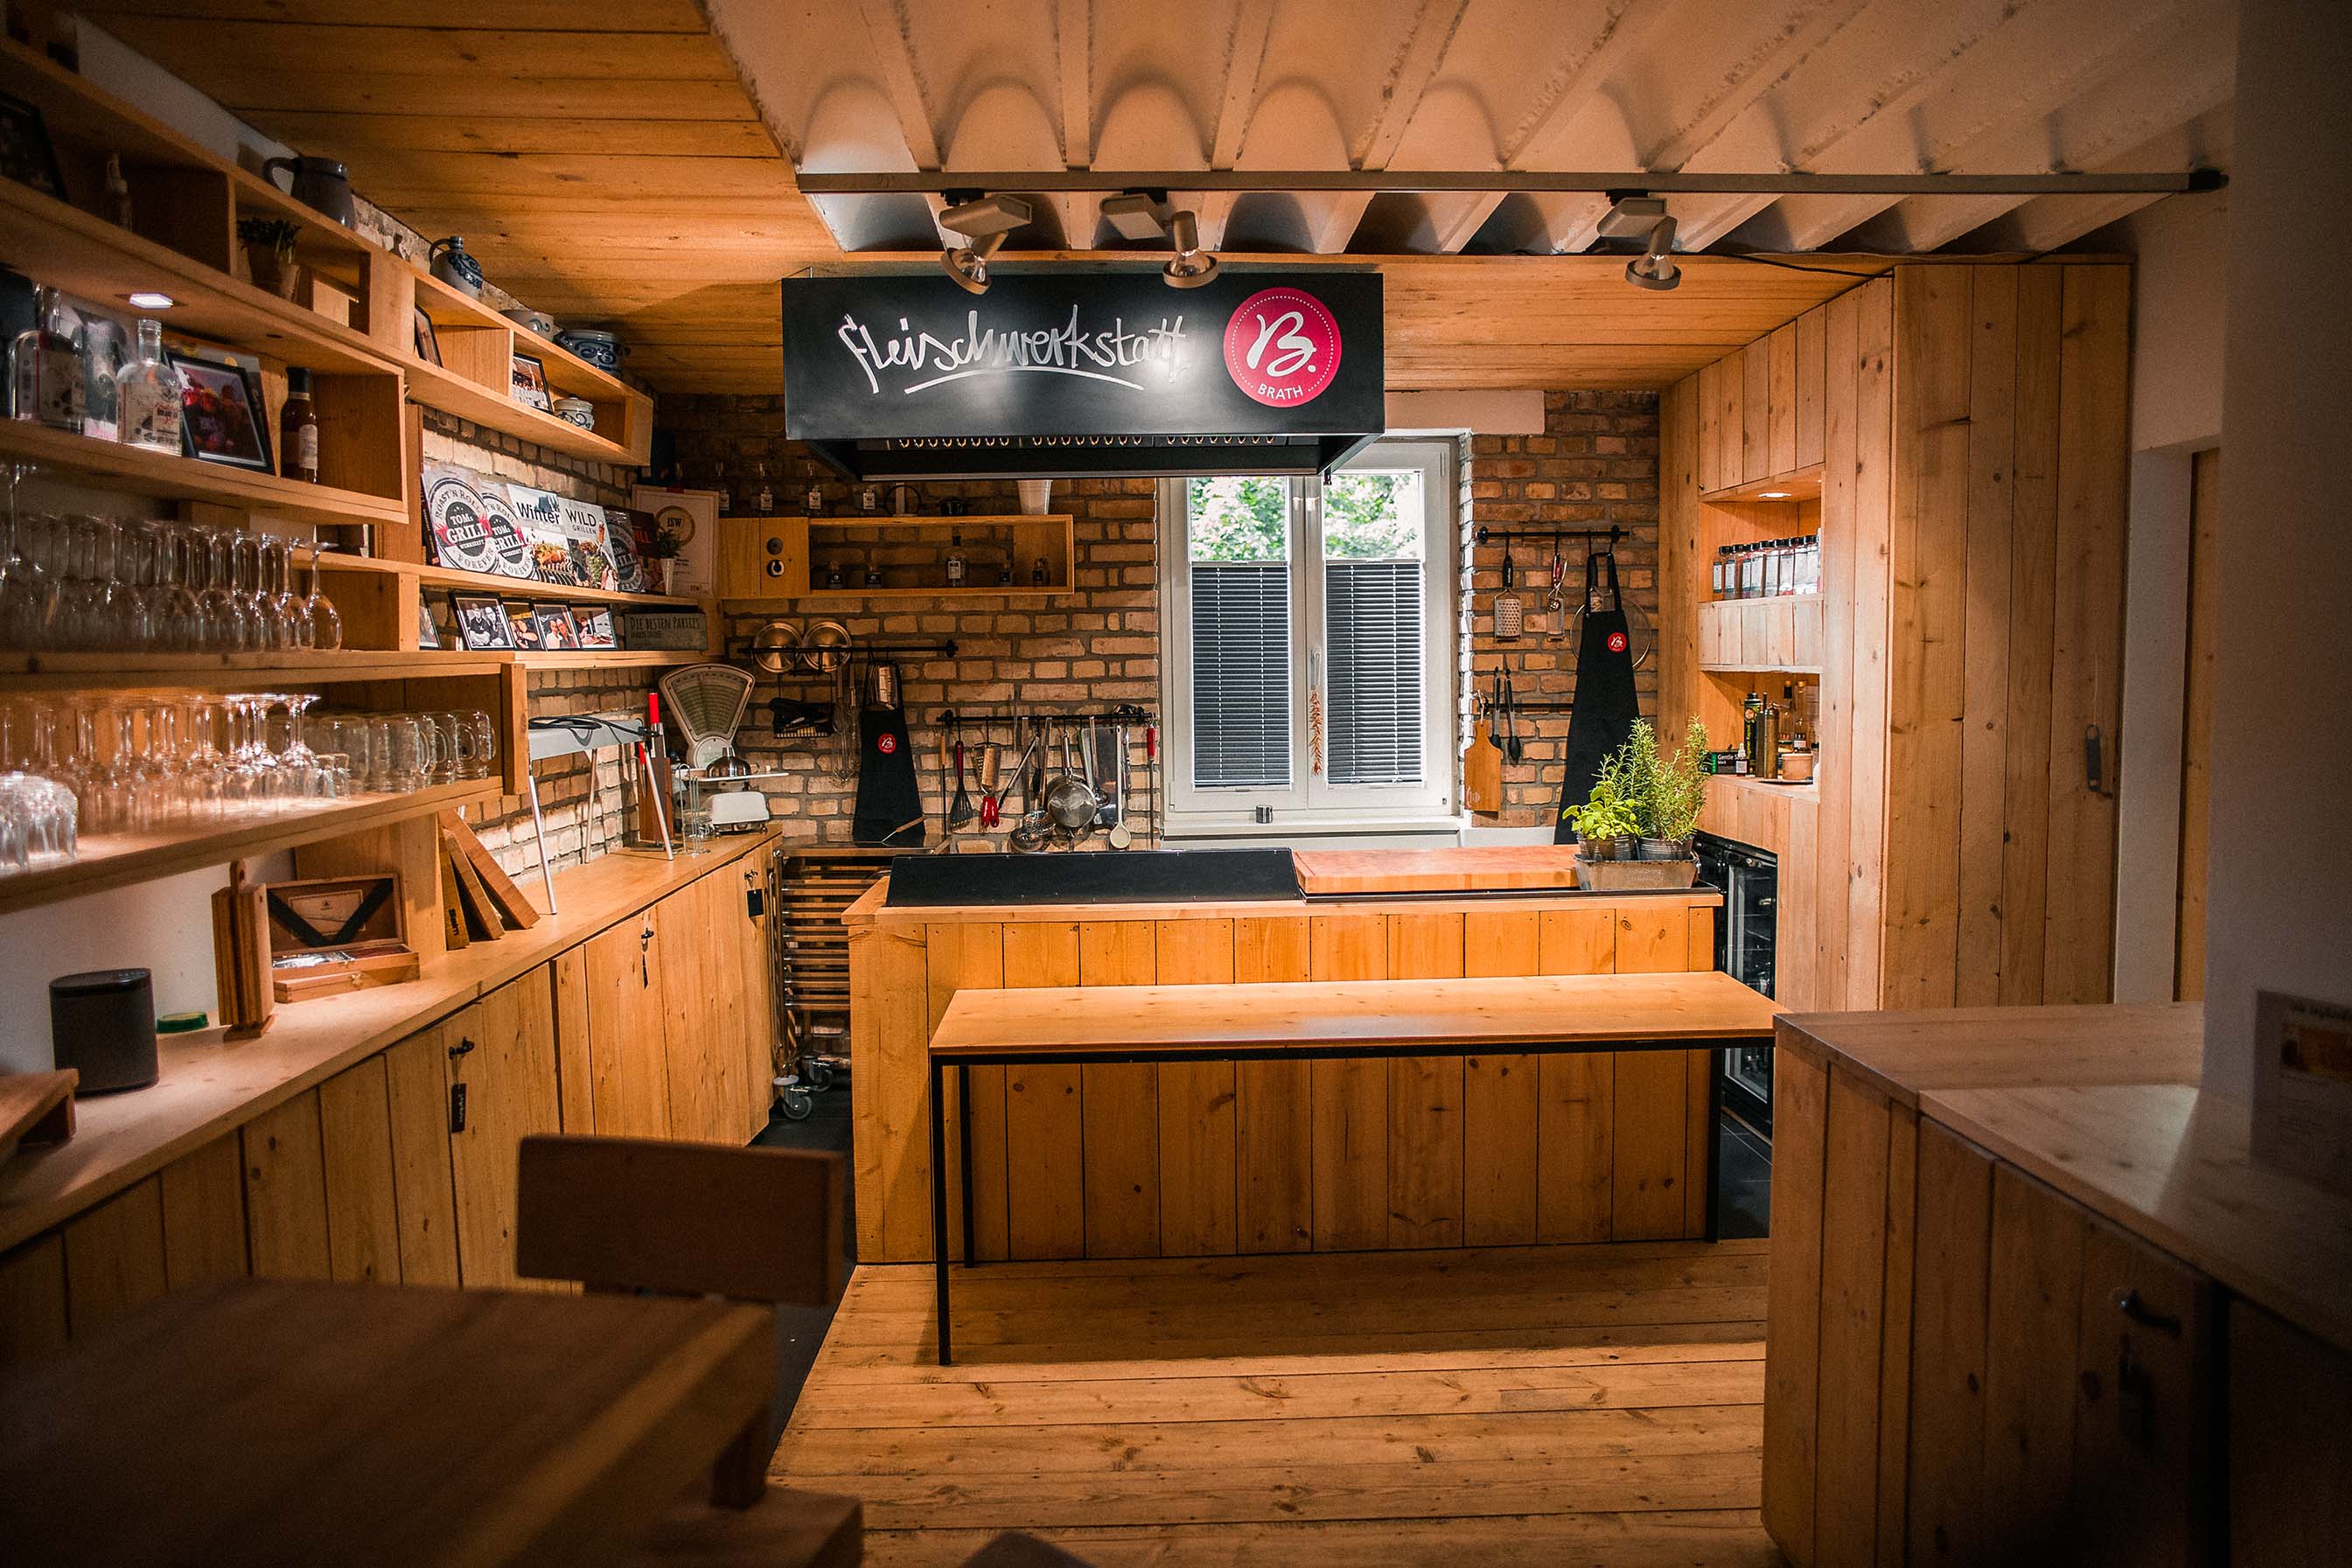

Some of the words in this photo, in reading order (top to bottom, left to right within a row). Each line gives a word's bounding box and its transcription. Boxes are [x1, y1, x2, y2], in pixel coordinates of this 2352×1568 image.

[1258, 383, 1304, 400] BRATH
[459, 490, 481, 514] ROLL
[516, 501, 560, 525] Winter
[565, 508, 597, 526] WILD
[667, 517, 682, 527] ISW
[446, 523, 489, 543] GRILL
[573, 525, 597, 534] GRILLEN
[457, 547, 493, 569] FOREVER
[630, 617, 643, 630] DIE
